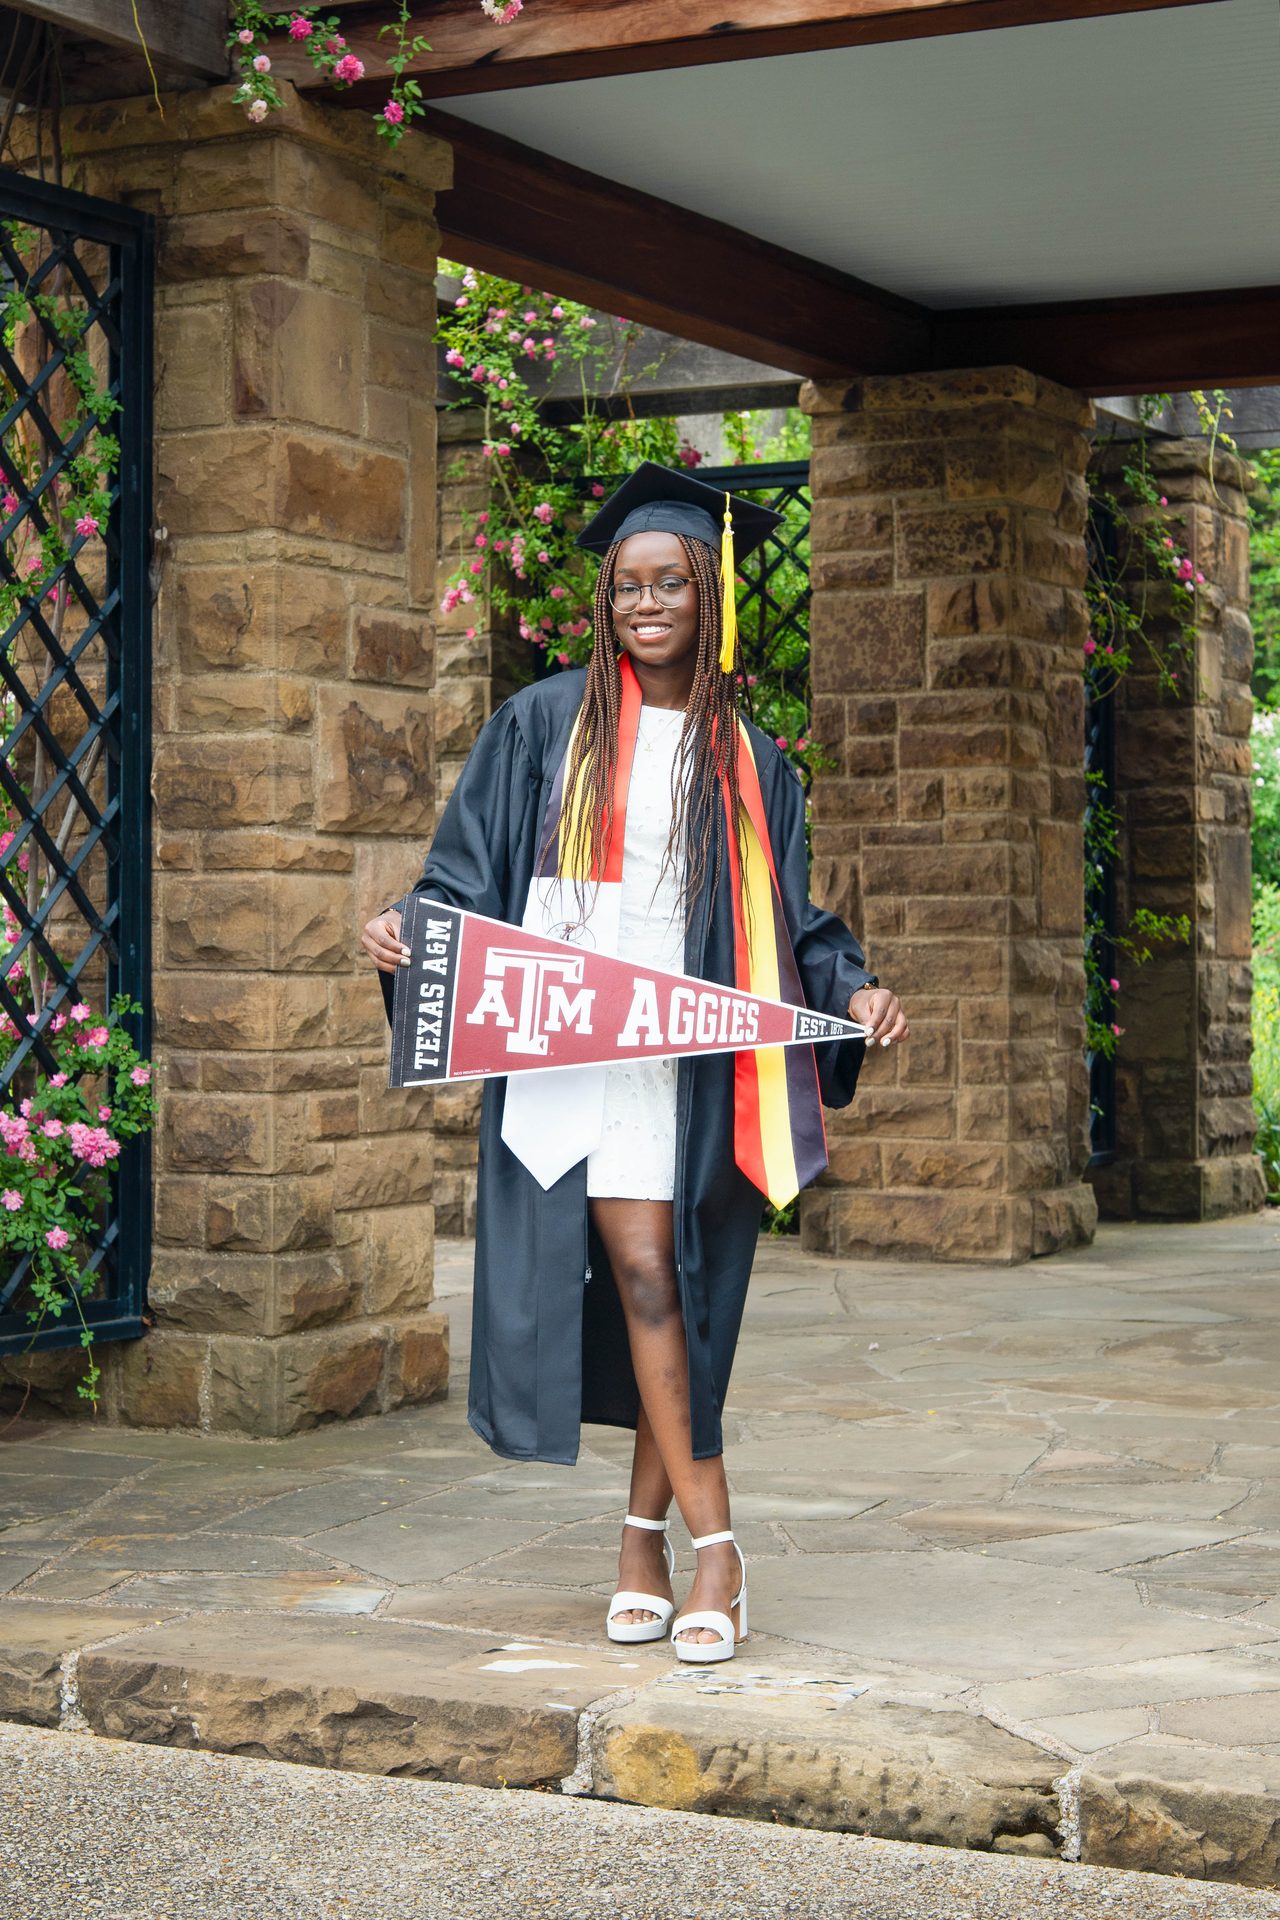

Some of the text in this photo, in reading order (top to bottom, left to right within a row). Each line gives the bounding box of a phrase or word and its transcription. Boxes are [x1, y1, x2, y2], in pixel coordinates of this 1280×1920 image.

[414, 918, 452, 1070] TEXAS A&M
[617, 977, 760, 1047] AGGIES
[799, 1015, 844, 1036] EST. 1876
